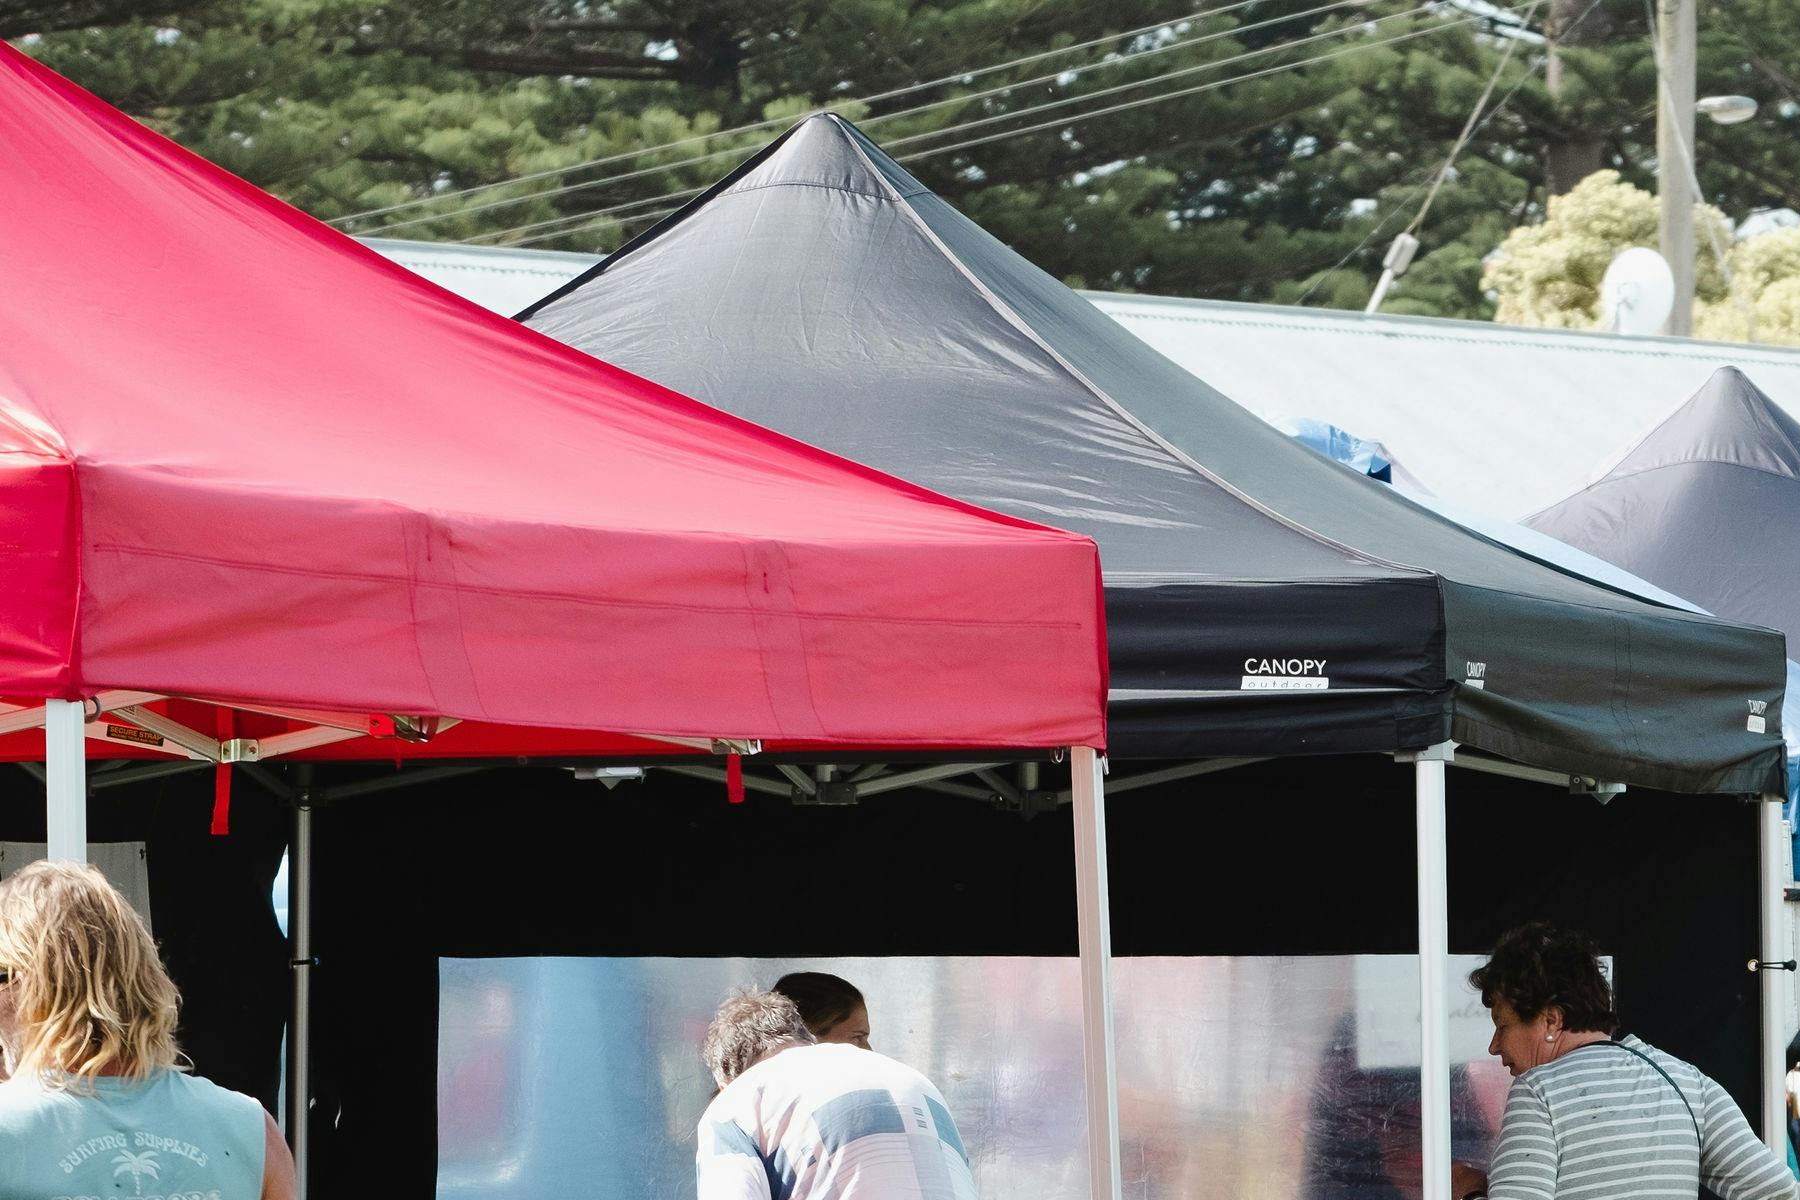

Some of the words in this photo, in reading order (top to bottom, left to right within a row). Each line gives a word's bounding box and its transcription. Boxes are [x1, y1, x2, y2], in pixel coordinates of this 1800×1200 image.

[1244, 658, 1327, 675] CANOPY
[1248, 681, 1322, 689] outdoor
[57, 1132, 128, 1174] SURFING
[134, 1131, 209, 1168] SUPPLIES
